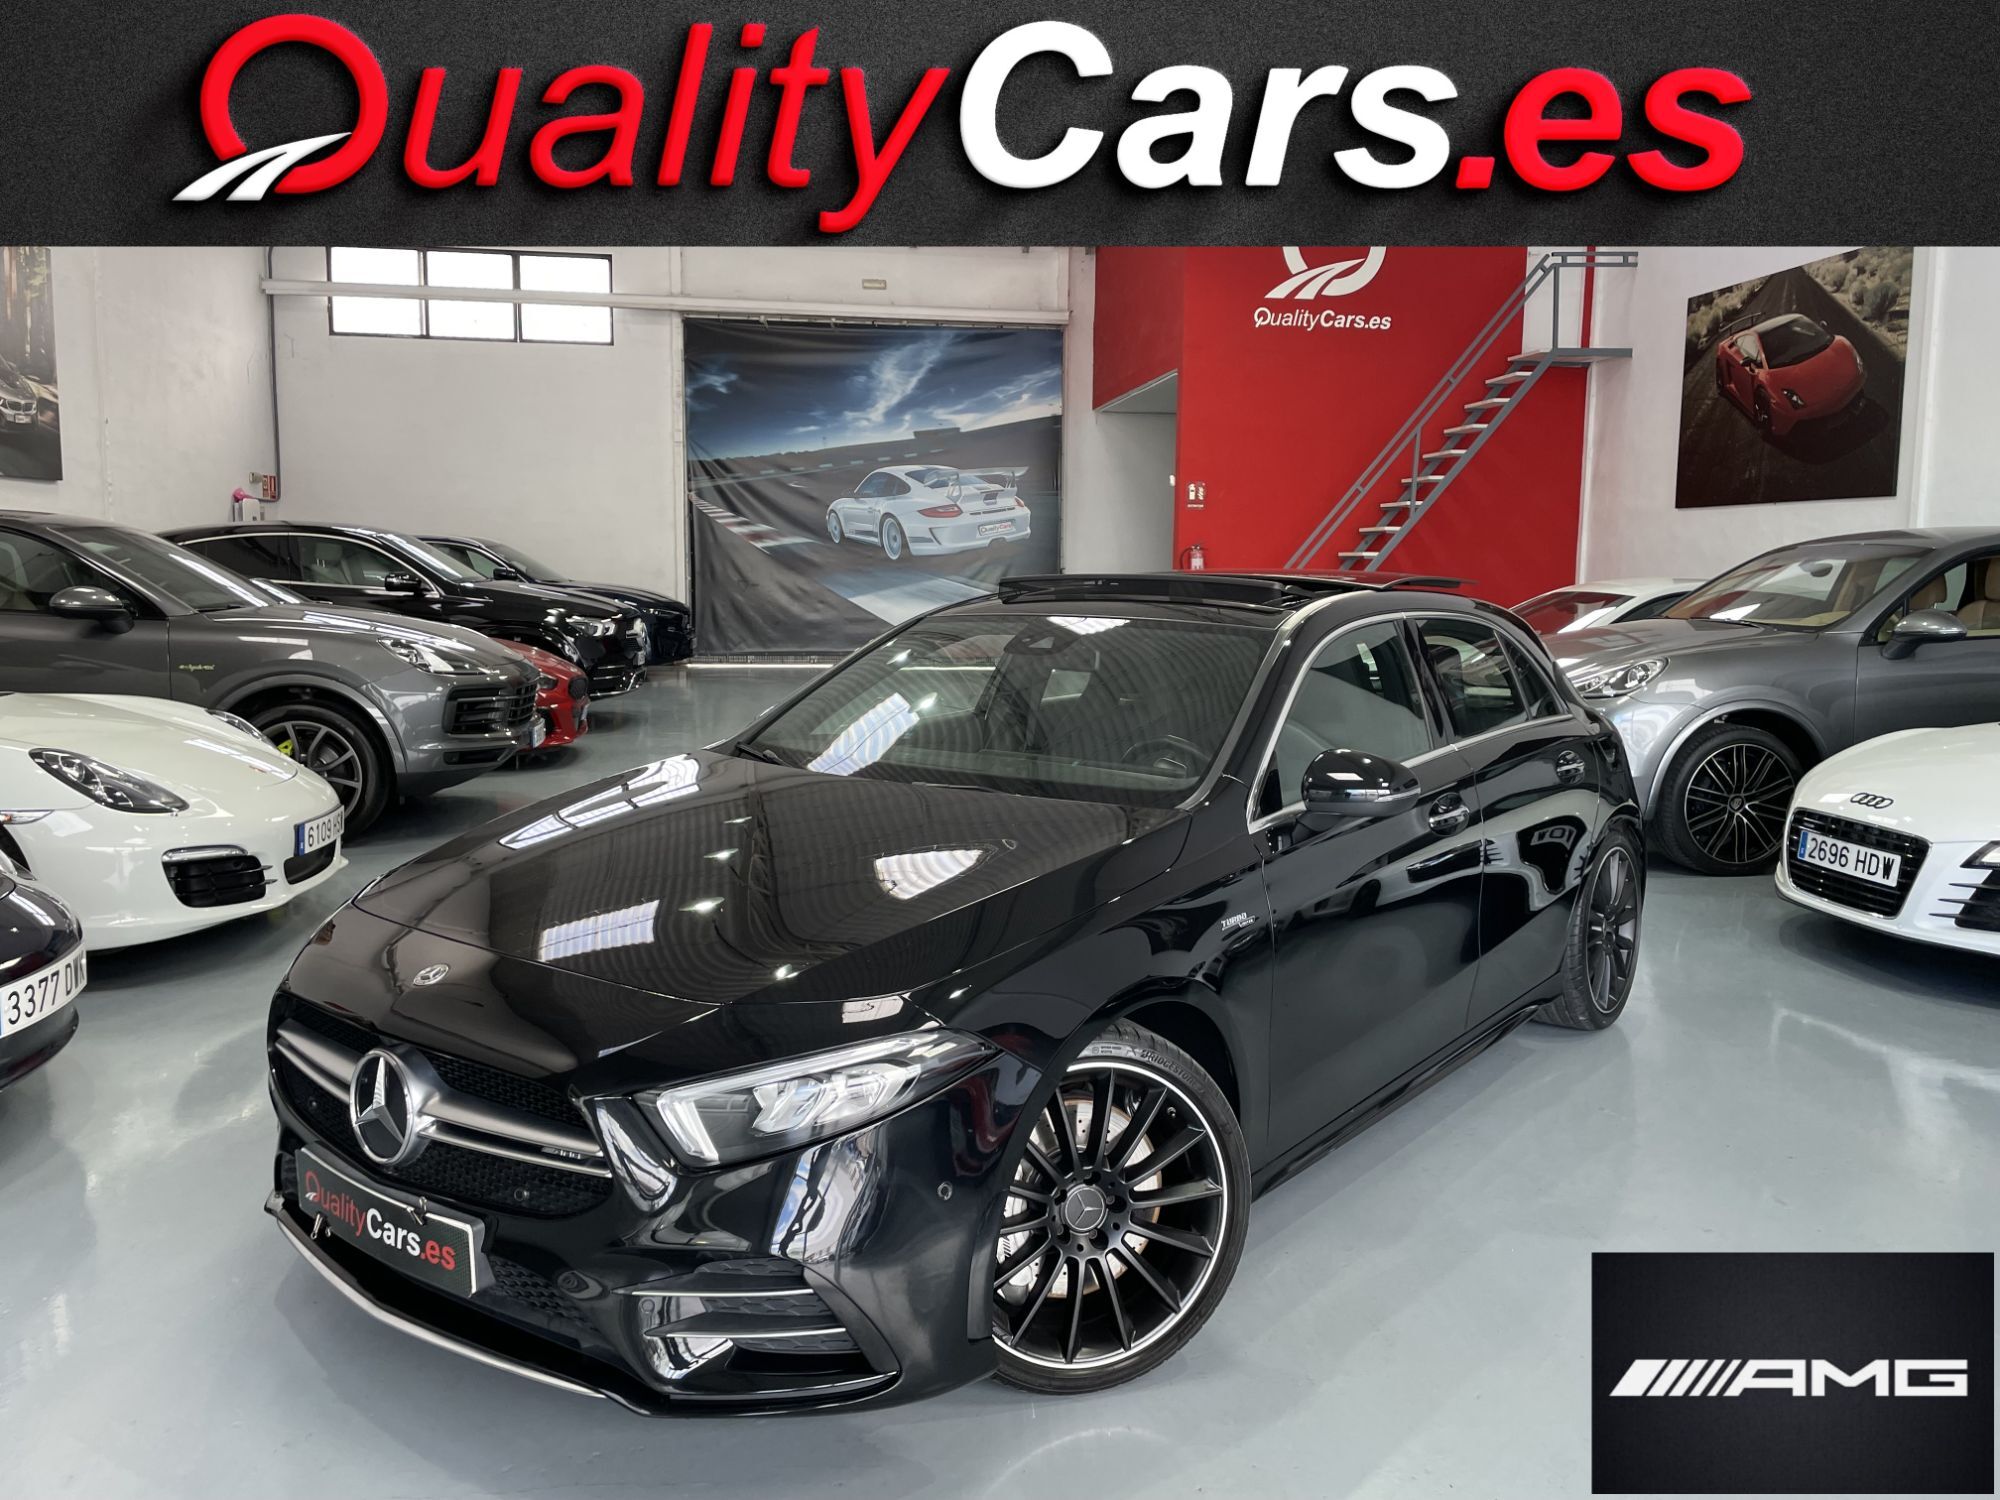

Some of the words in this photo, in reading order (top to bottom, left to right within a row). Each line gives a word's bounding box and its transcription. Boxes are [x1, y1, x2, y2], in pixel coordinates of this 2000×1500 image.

[1254, 307, 1392, 331] QualityCars.es
[307, 818, 332, 848] 6109
[1808, 838, 1850, 868] 2696
[1854, 849, 1895, 880] HDW
[7, 970, 60, 1025] 3377
[305, 1169, 456, 1271] QualityCars.es
